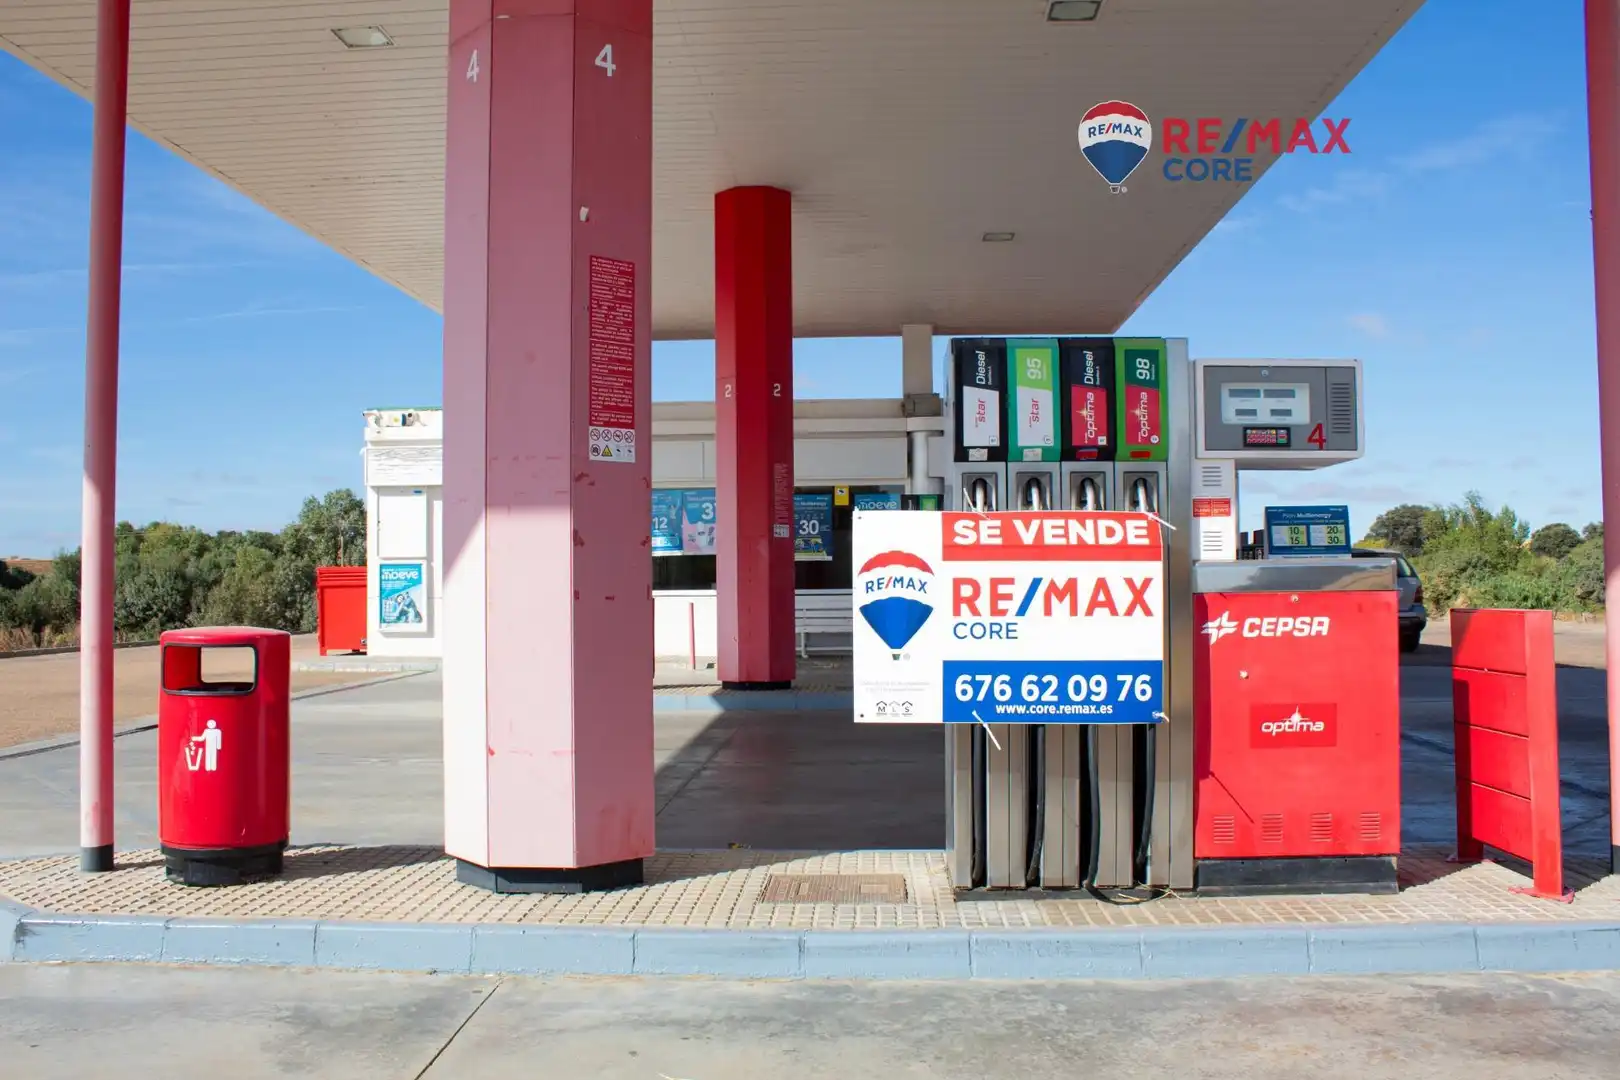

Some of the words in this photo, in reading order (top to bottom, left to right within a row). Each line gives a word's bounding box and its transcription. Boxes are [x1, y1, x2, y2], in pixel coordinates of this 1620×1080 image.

[466, 48, 480, 83] 4
[594, 43, 616, 77] 4
[975, 350, 986, 385] Diesel
[1026, 357, 1042, 380] 95
[1083, 350, 1094, 385] Diesel
[1136, 357, 1150, 380] 98
[725, 384, 732, 398] 2
[773, 383, 781, 397] 2
[976, 399, 986, 423] star
[1030, 398, 1040, 423] star
[1084, 392, 1097, 438] optima
[1138, 392, 1151, 438] optima
[1307, 423, 1327, 450] 4
[857, 501, 897, 510] moeve
[798, 519, 819, 535] 30
[952, 518, 1002, 545] SE
[1012, 518, 1150, 545] VENDE
[1289, 526, 1300, 535] 10
[1327, 526, 1339, 535] 20
[1289, 536, 1300, 545] 15
[1327, 536, 1339, 544] 30
[382, 570, 419, 580] moeve
[865, 575, 928, 594] RE/MAX
[952, 577, 1154, 617] RE/MAX
[953, 622, 1018, 640] CORE
[1242, 616, 1331, 638] CEPSA
[954, 674, 1012, 702] 676
[1020, 674, 1059, 702] 62
[1067, 674, 1108, 702] 09
[1116, 674, 1152, 702] 76
[995, 703, 1114, 715] www.core.remax.es
[1261, 715, 1325, 737] optima
